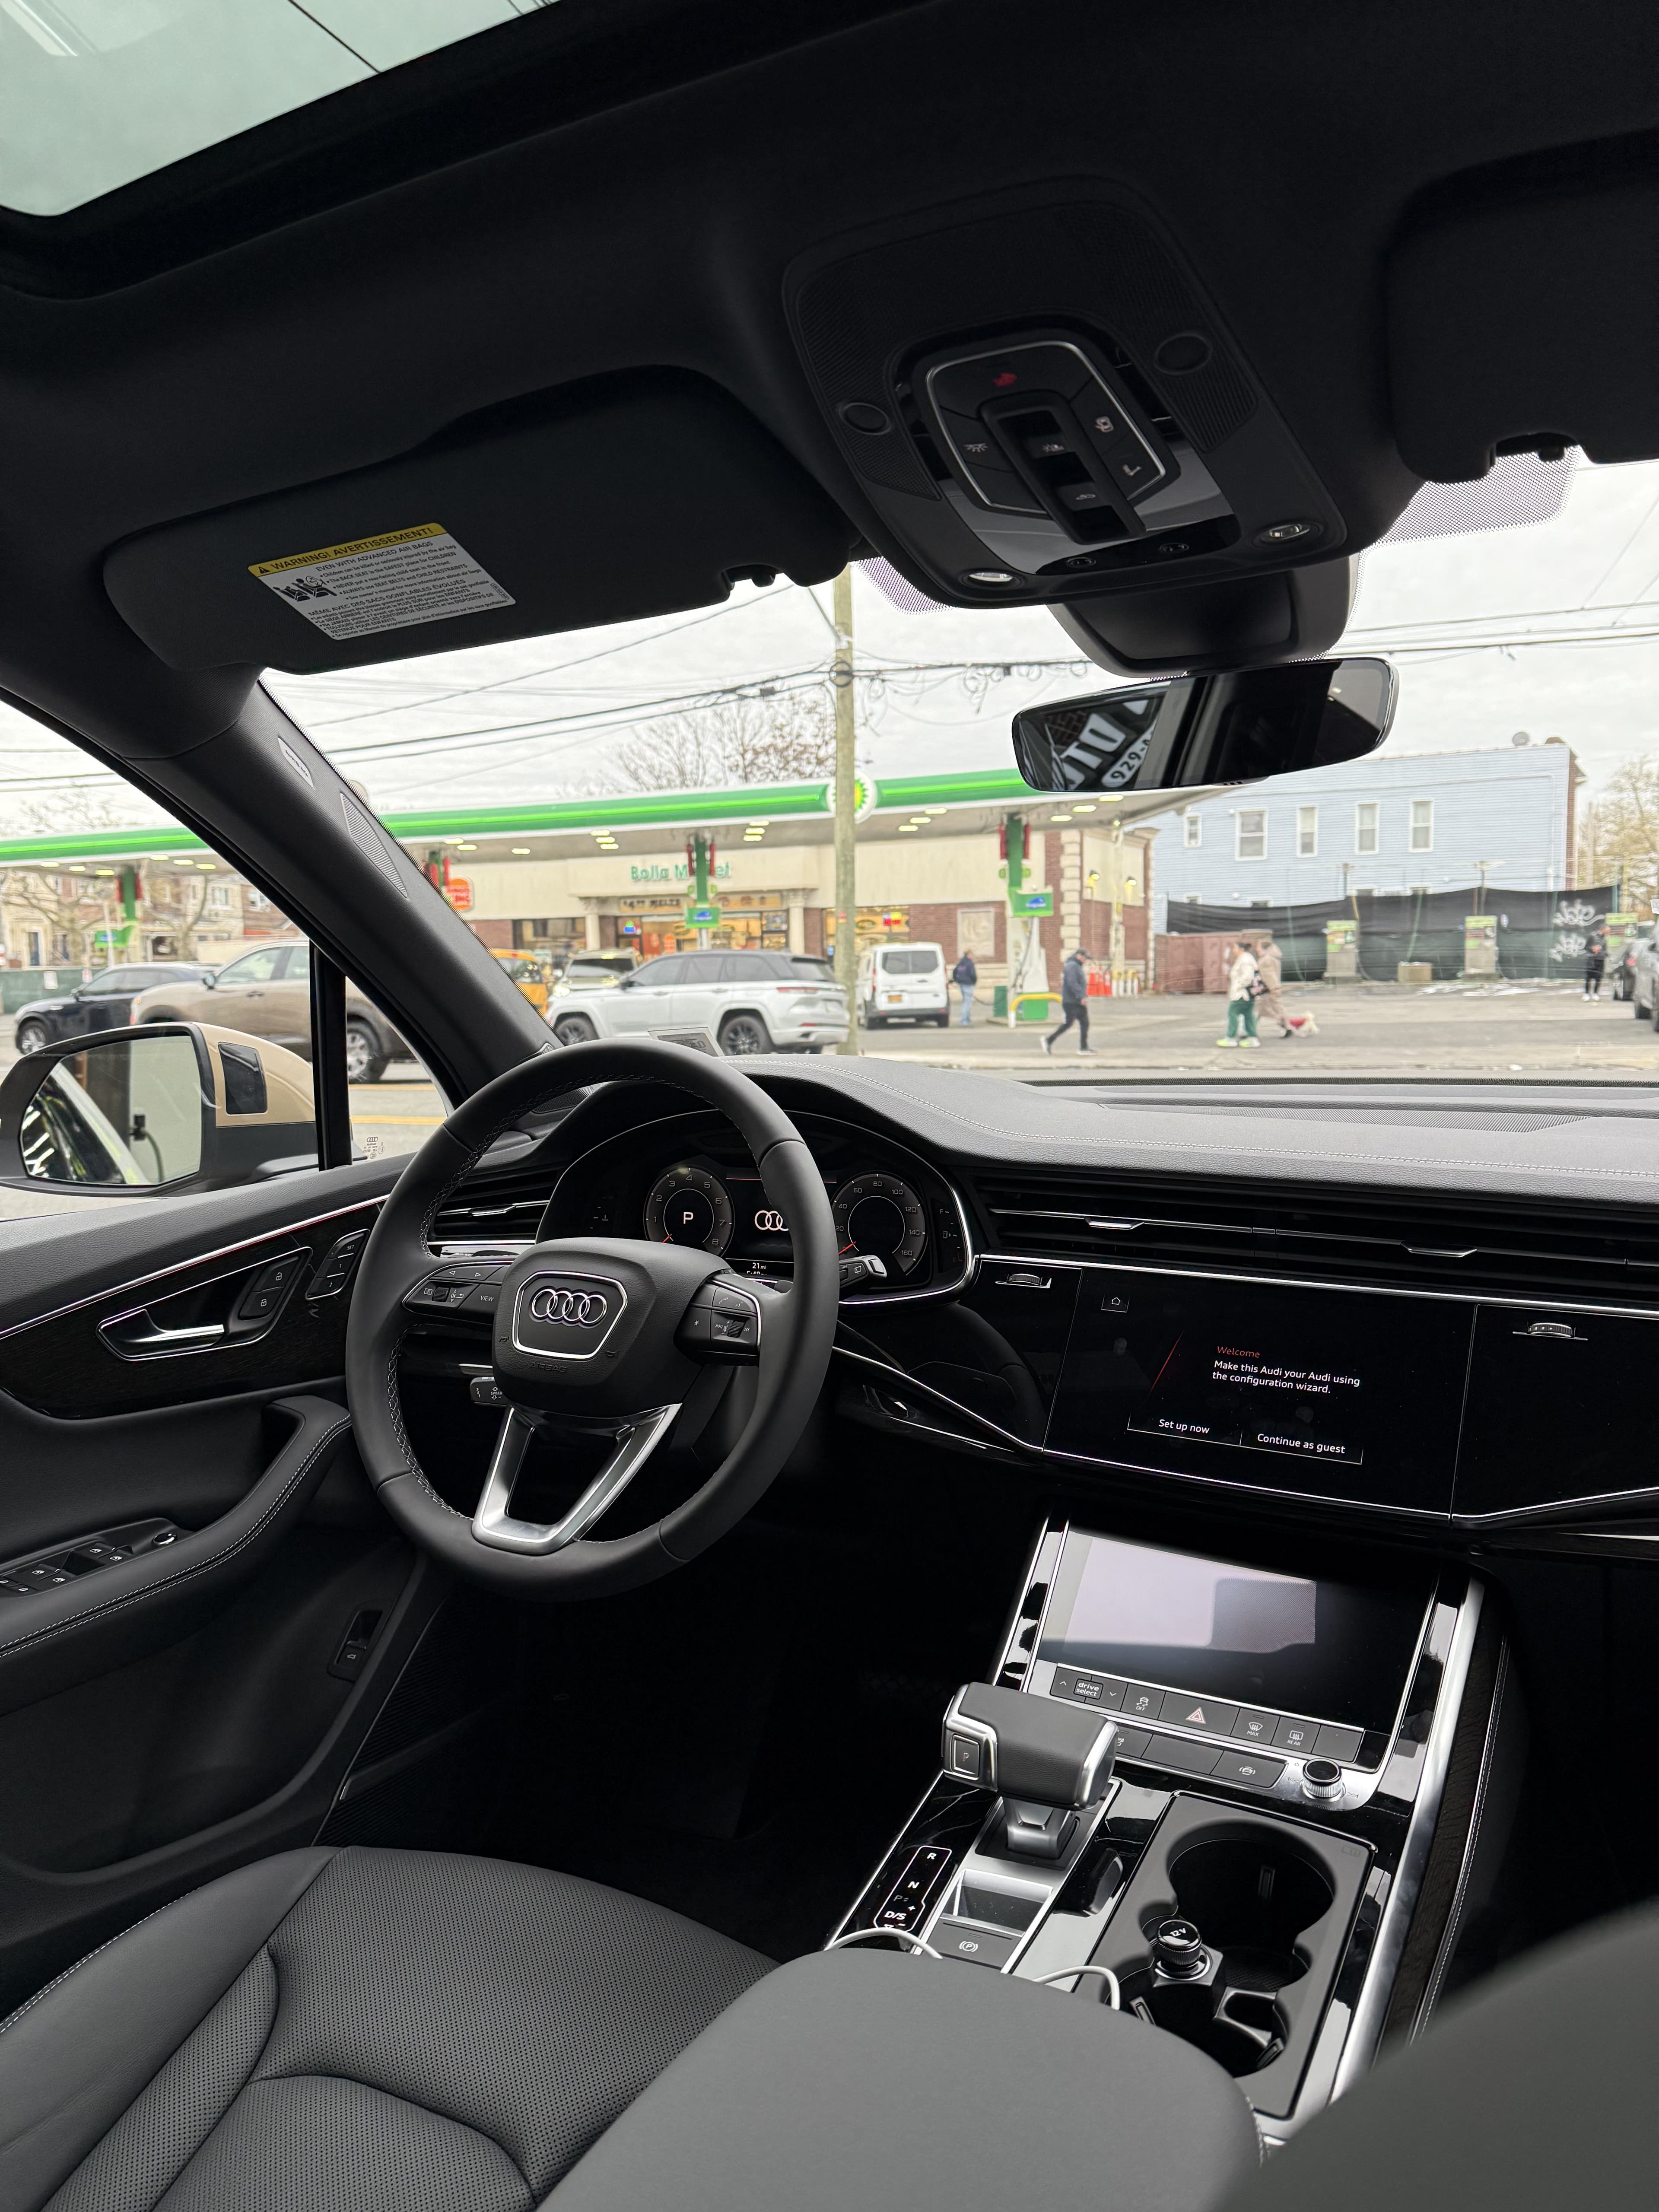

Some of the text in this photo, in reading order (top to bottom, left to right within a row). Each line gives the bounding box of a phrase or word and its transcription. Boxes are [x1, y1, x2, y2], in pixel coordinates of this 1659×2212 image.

[270, 528, 433, 569] WARNING! AVERTISSEMENT!
[358, 550, 397, 562] ADVANCED
[428, 552, 456, 560] CHILDREN
[433, 564, 467, 575] RESTRAINTS
[386, 586, 432, 599] GONFLABLES
[630, 864, 670, 881] Bolla
[683, 1211, 694, 1224] P
[1217, 1346, 1260, 1358] Welcome
[1214, 1360, 1360, 1387] Make this Audi your Audi using
[1212, 1372, 1331, 1393] the configuration wizard.
[1159, 1419, 1210, 1434] Set up now
[1257, 1433, 1301, 1447] Continue
[1316, 1443, 1345, 1453] guest
[1076, 1688, 1097, 1697] select
[1078, 1682, 1100, 1691] drive
[962, 1752, 969, 1762] P
[884, 1911, 907, 1920] D/S
